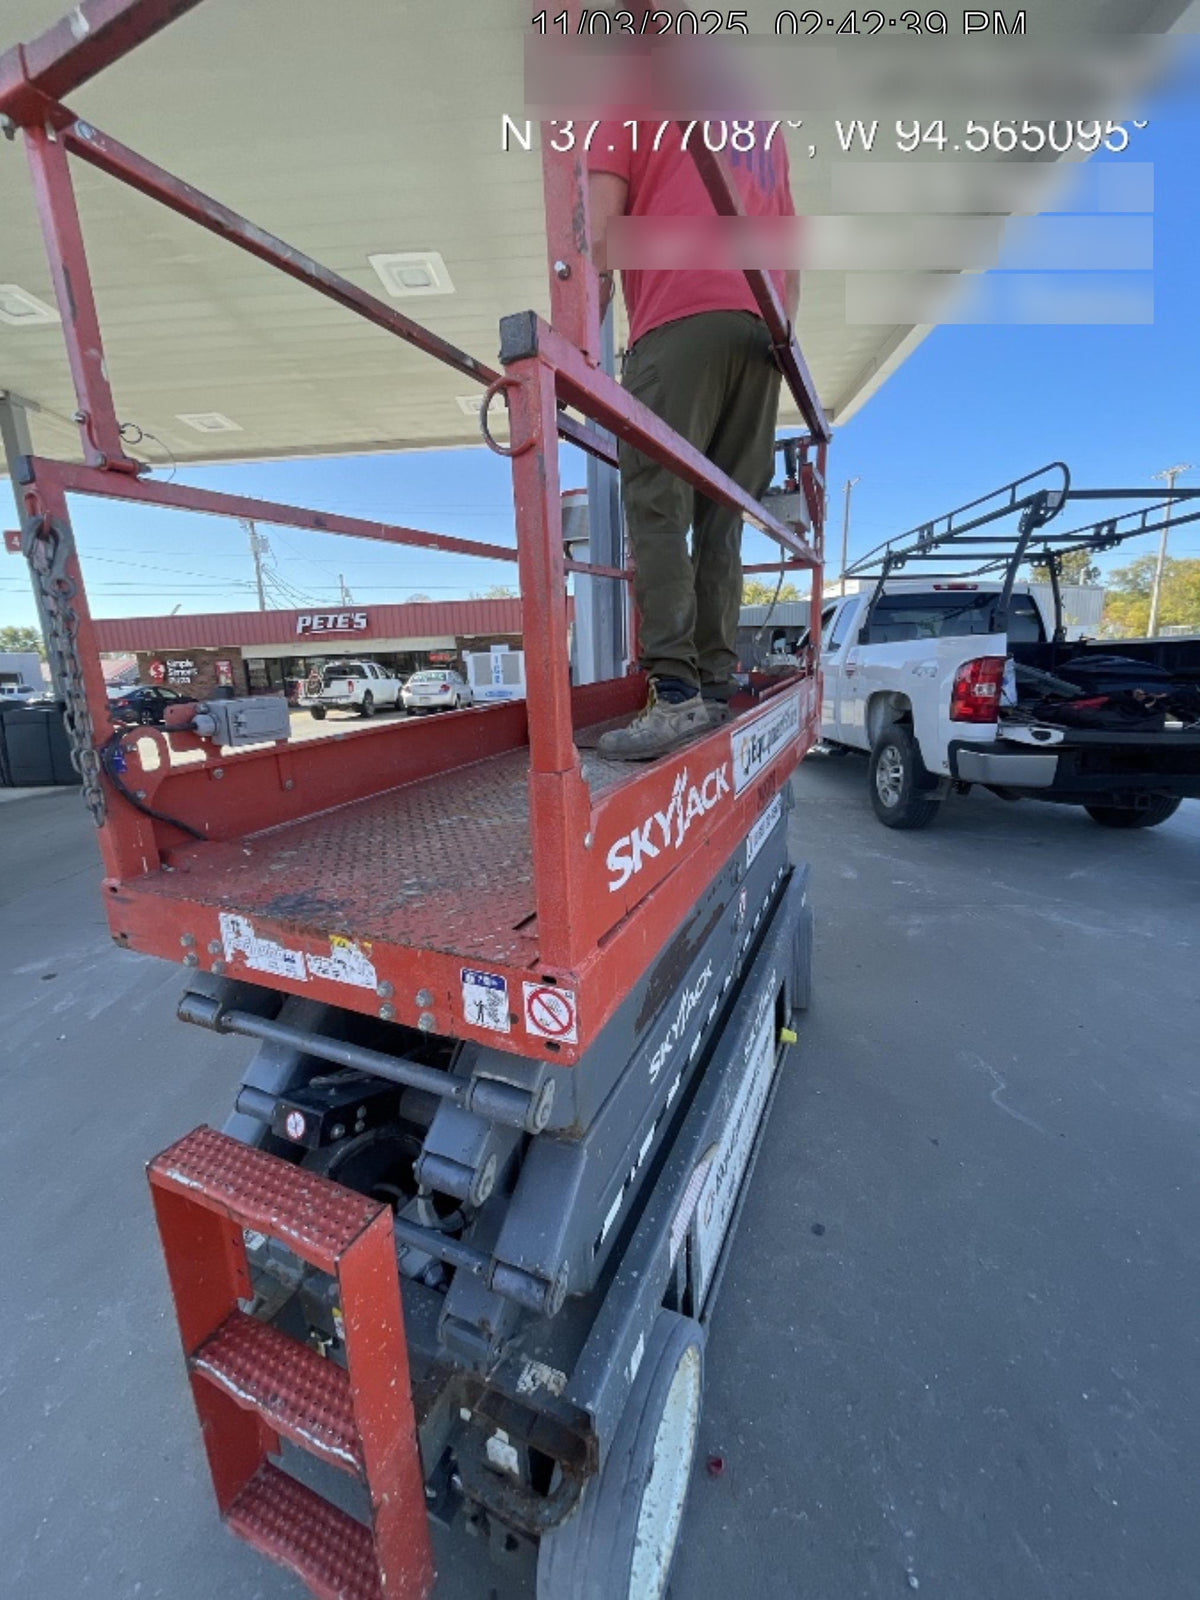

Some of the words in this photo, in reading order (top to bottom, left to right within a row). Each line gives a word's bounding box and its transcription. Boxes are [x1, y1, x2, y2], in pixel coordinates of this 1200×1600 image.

[297, 612, 367, 635] PETE'S
[606, 762, 730, 893] SKYJACK
[649, 958, 713, 1085] SKYJACK
